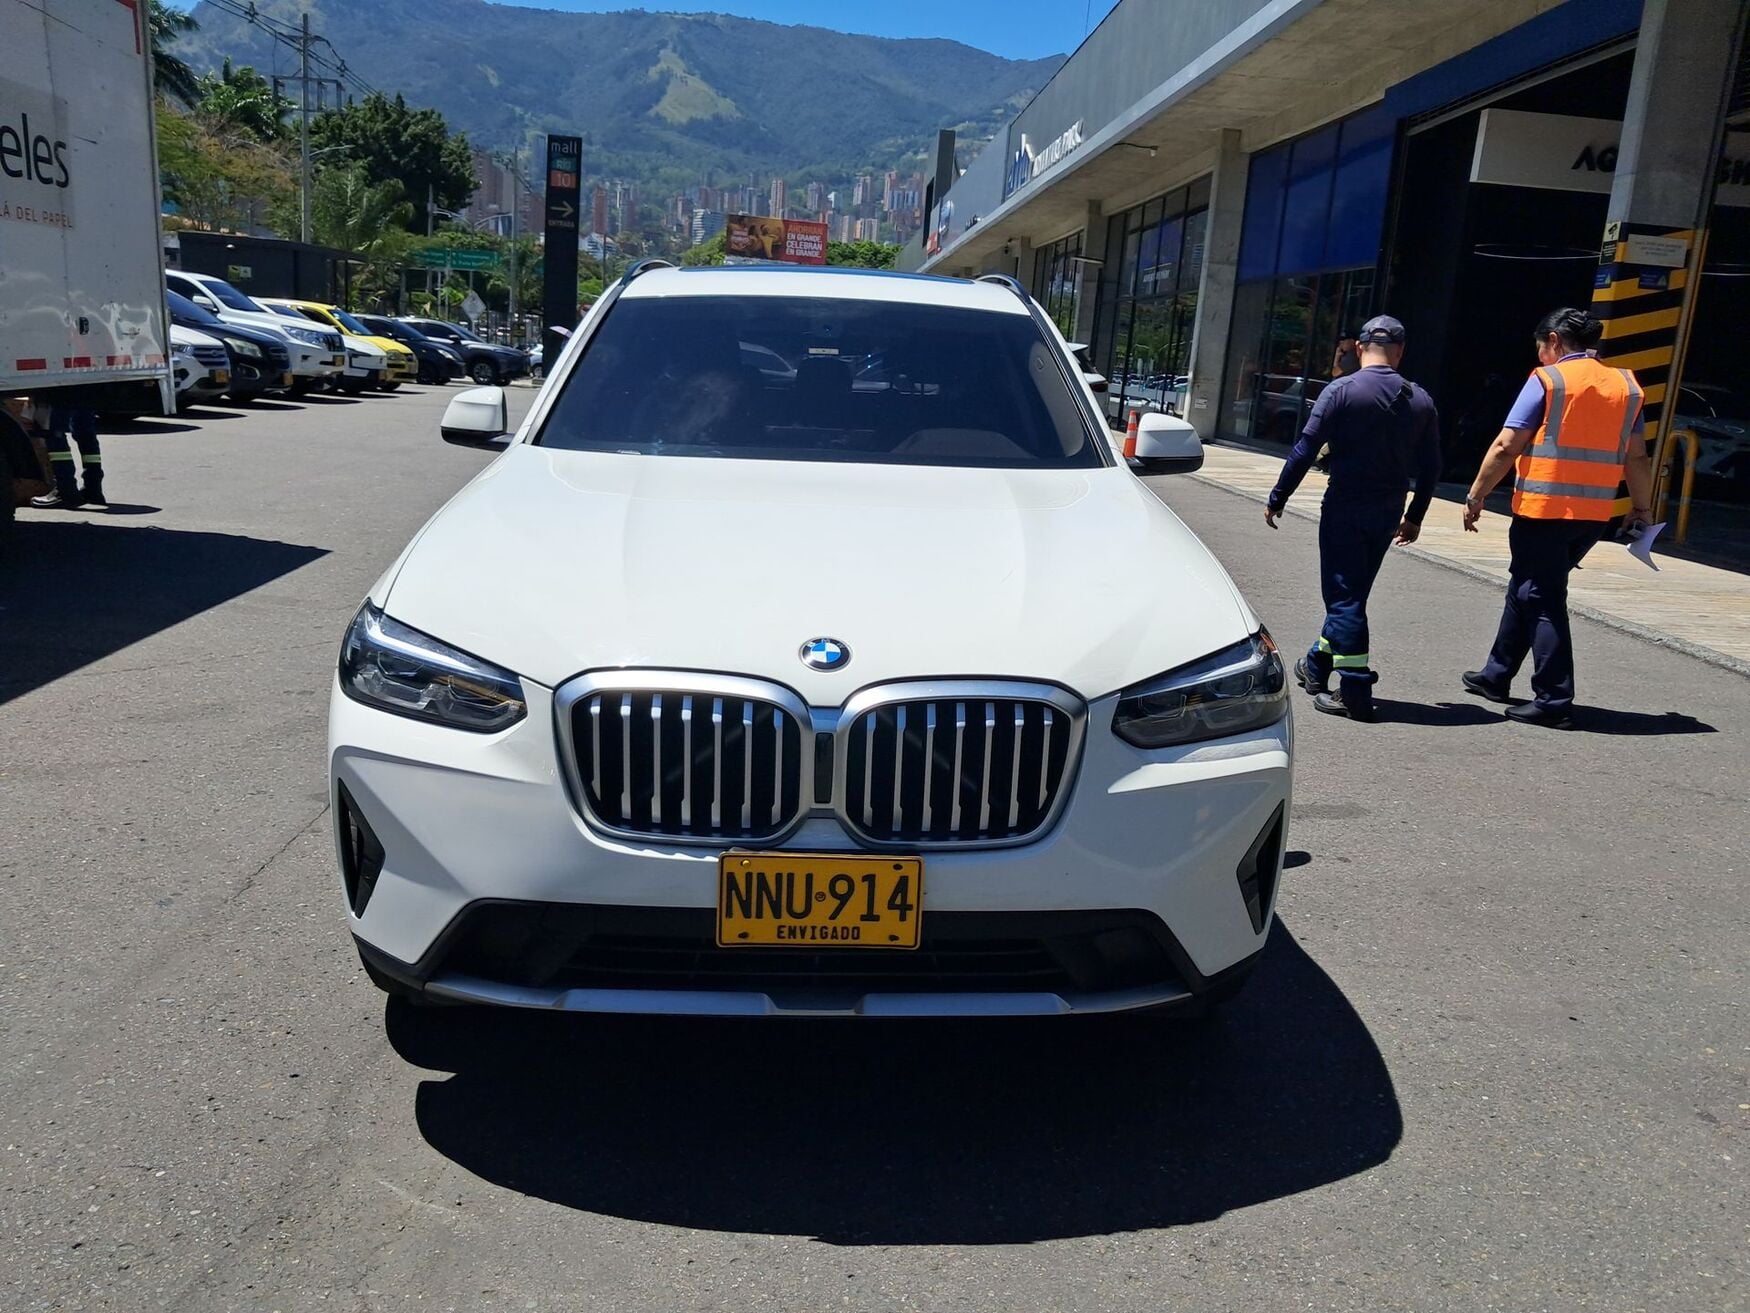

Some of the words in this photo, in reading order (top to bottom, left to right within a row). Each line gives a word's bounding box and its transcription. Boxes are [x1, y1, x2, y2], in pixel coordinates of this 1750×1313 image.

[551, 141, 577, 154] mall
[16, 206, 38, 222] DEL
[43, 210, 73, 228] PAPEL
[786, 240, 823, 251] CELEBRAN
[725, 871, 814, 920] NNU
[828, 873, 914, 922] 914
[776, 924, 861, 940] ENVIGADO
